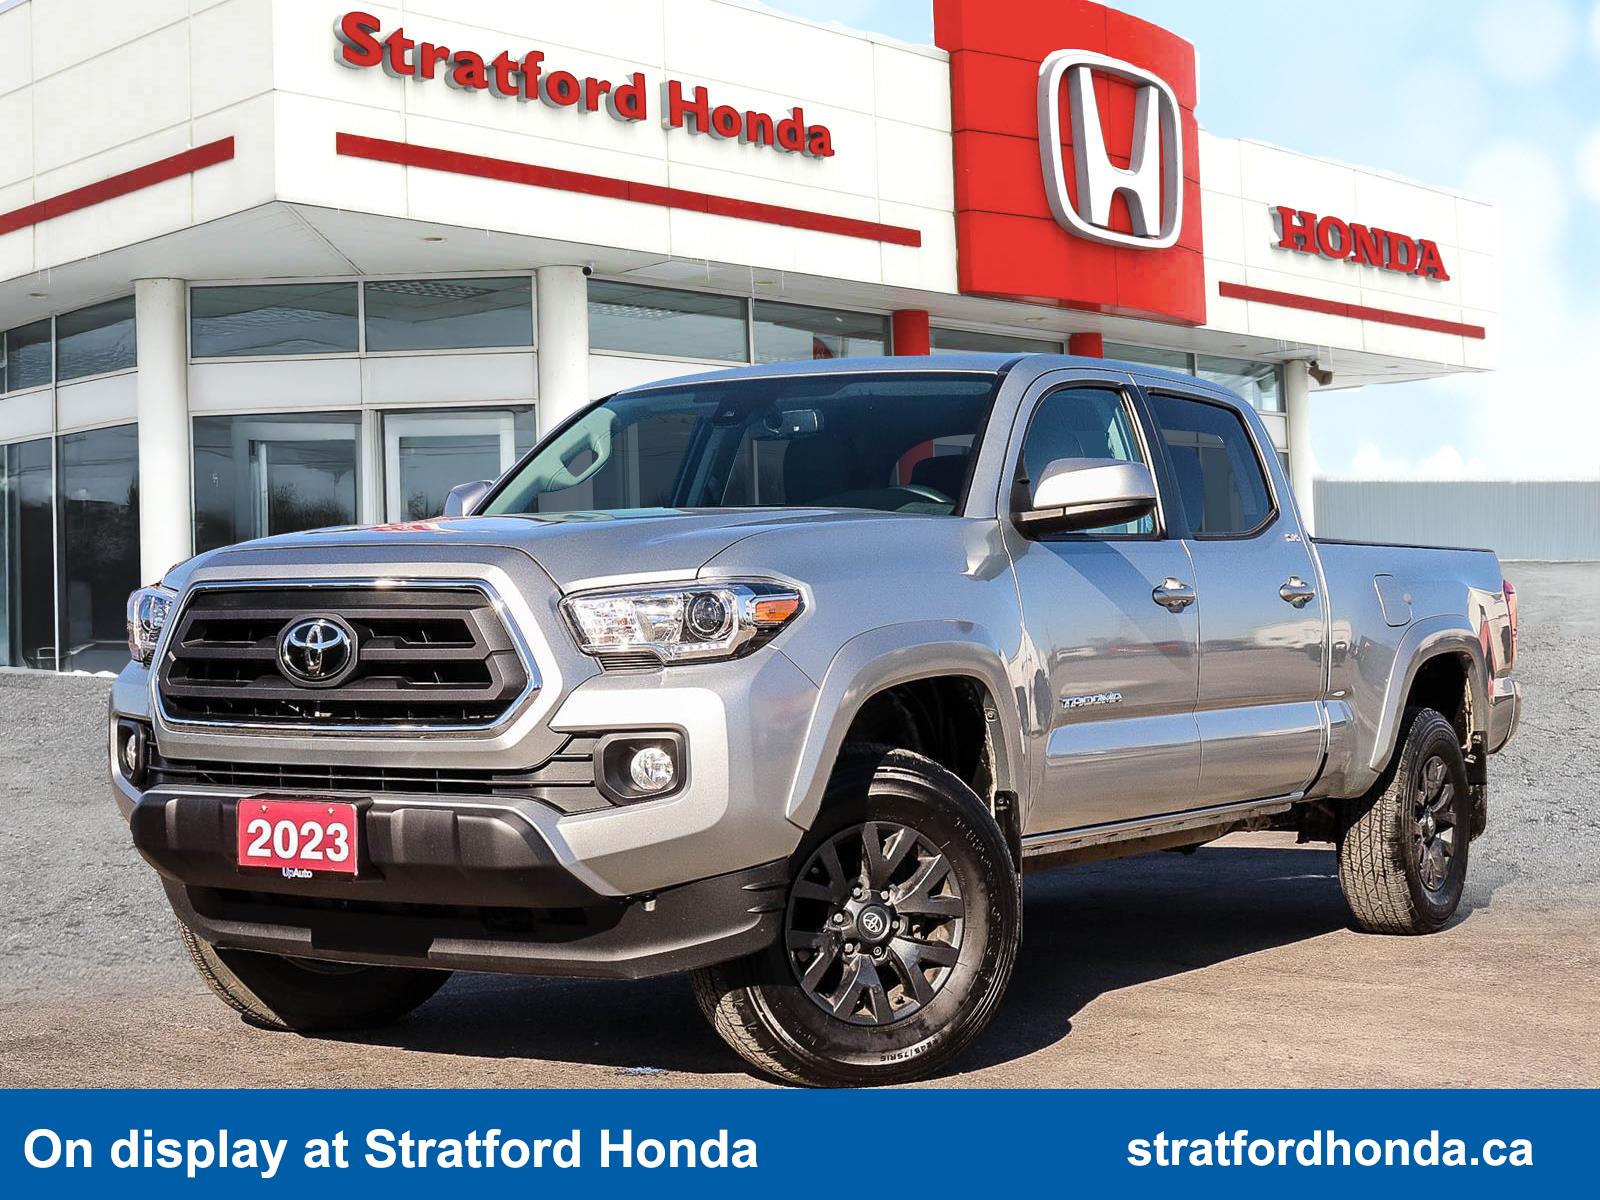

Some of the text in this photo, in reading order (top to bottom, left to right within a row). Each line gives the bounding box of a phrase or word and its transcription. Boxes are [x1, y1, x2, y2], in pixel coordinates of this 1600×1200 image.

[335, 11, 835, 159] Stratford Honda
[1269, 206, 1450, 282] HONDA
[247, 818, 349, 862] 2023
[282, 867, 313, 879] UpAuto
